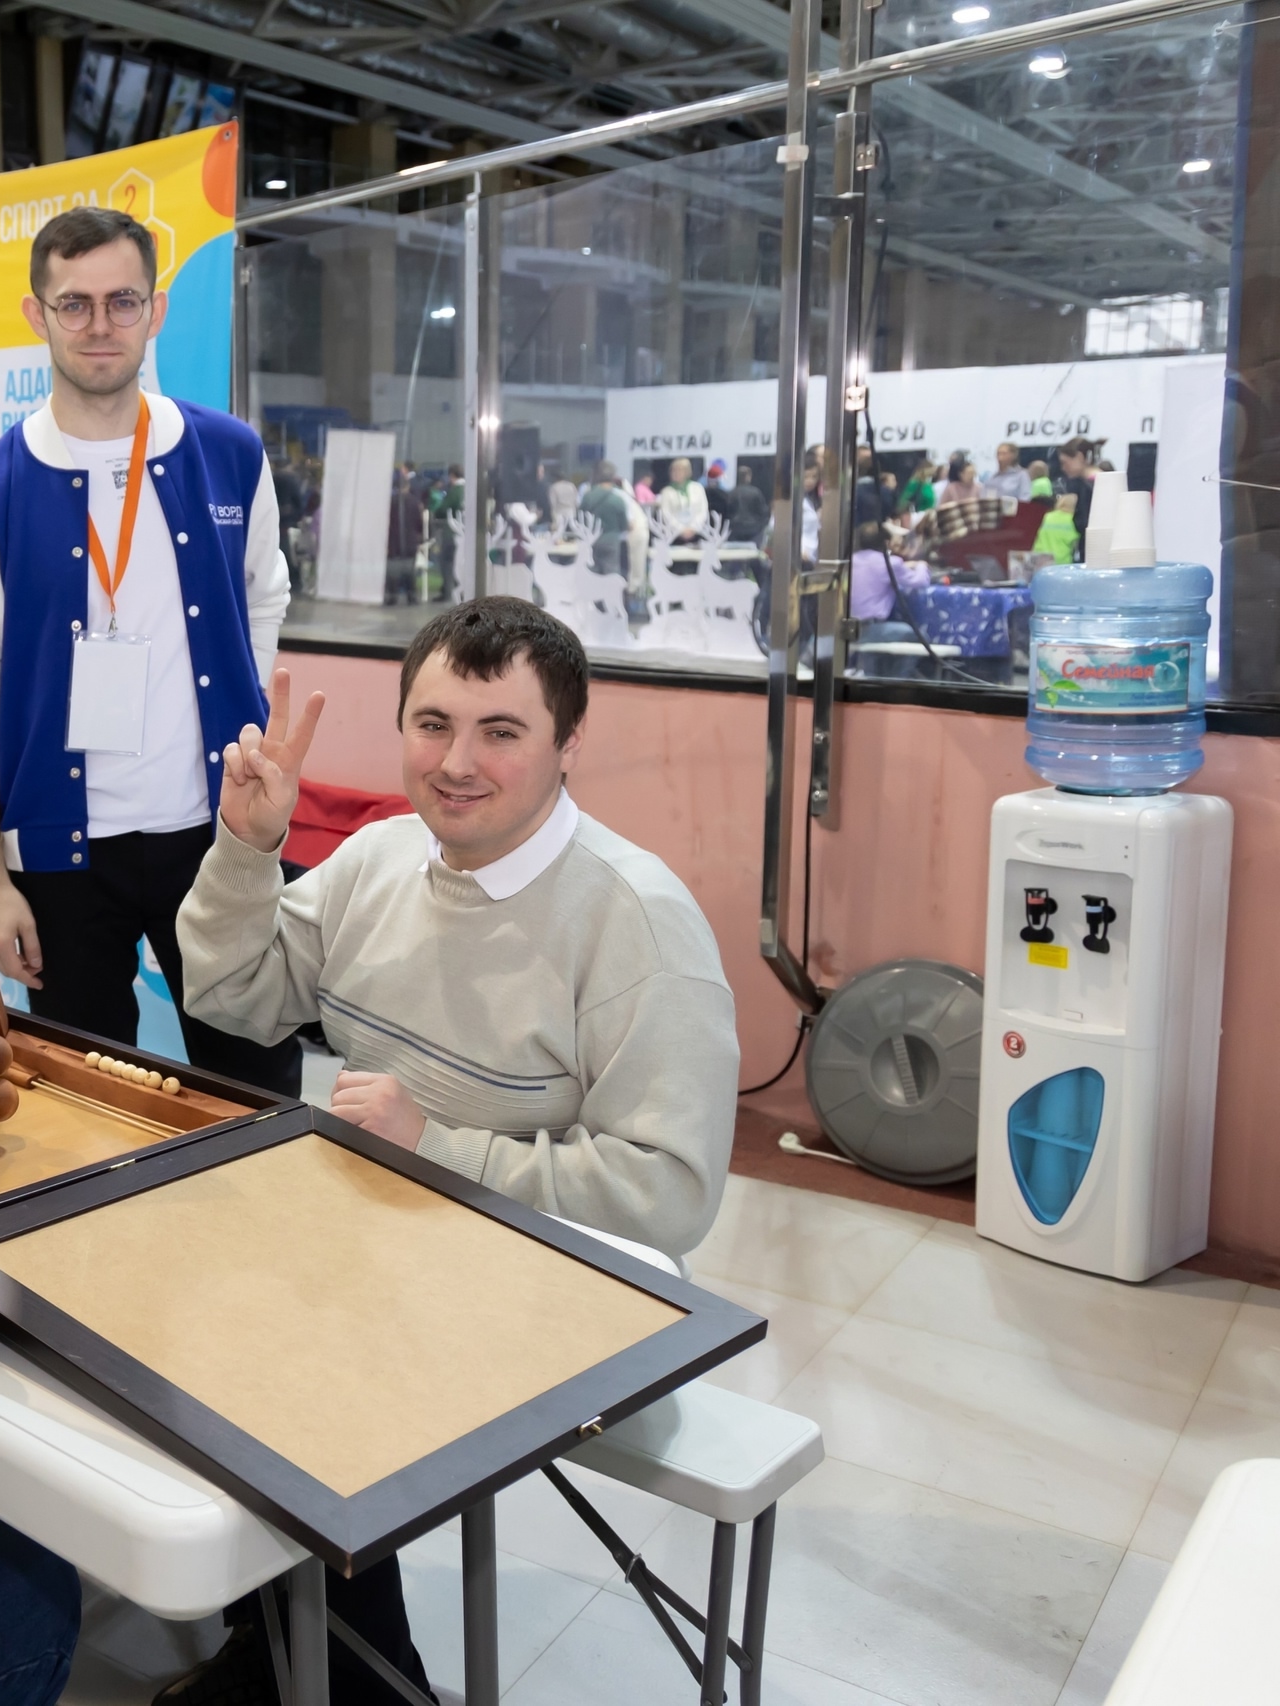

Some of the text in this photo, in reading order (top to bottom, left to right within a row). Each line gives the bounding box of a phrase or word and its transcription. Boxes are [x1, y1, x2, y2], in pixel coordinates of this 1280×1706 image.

[1006, 415, 1091, 437] РИСУЙ
[631, 430, 712, 451] МЕЧТАЙ
[745, 431, 777, 448] ПИ
[1061, 658, 1155, 680] Семейная
